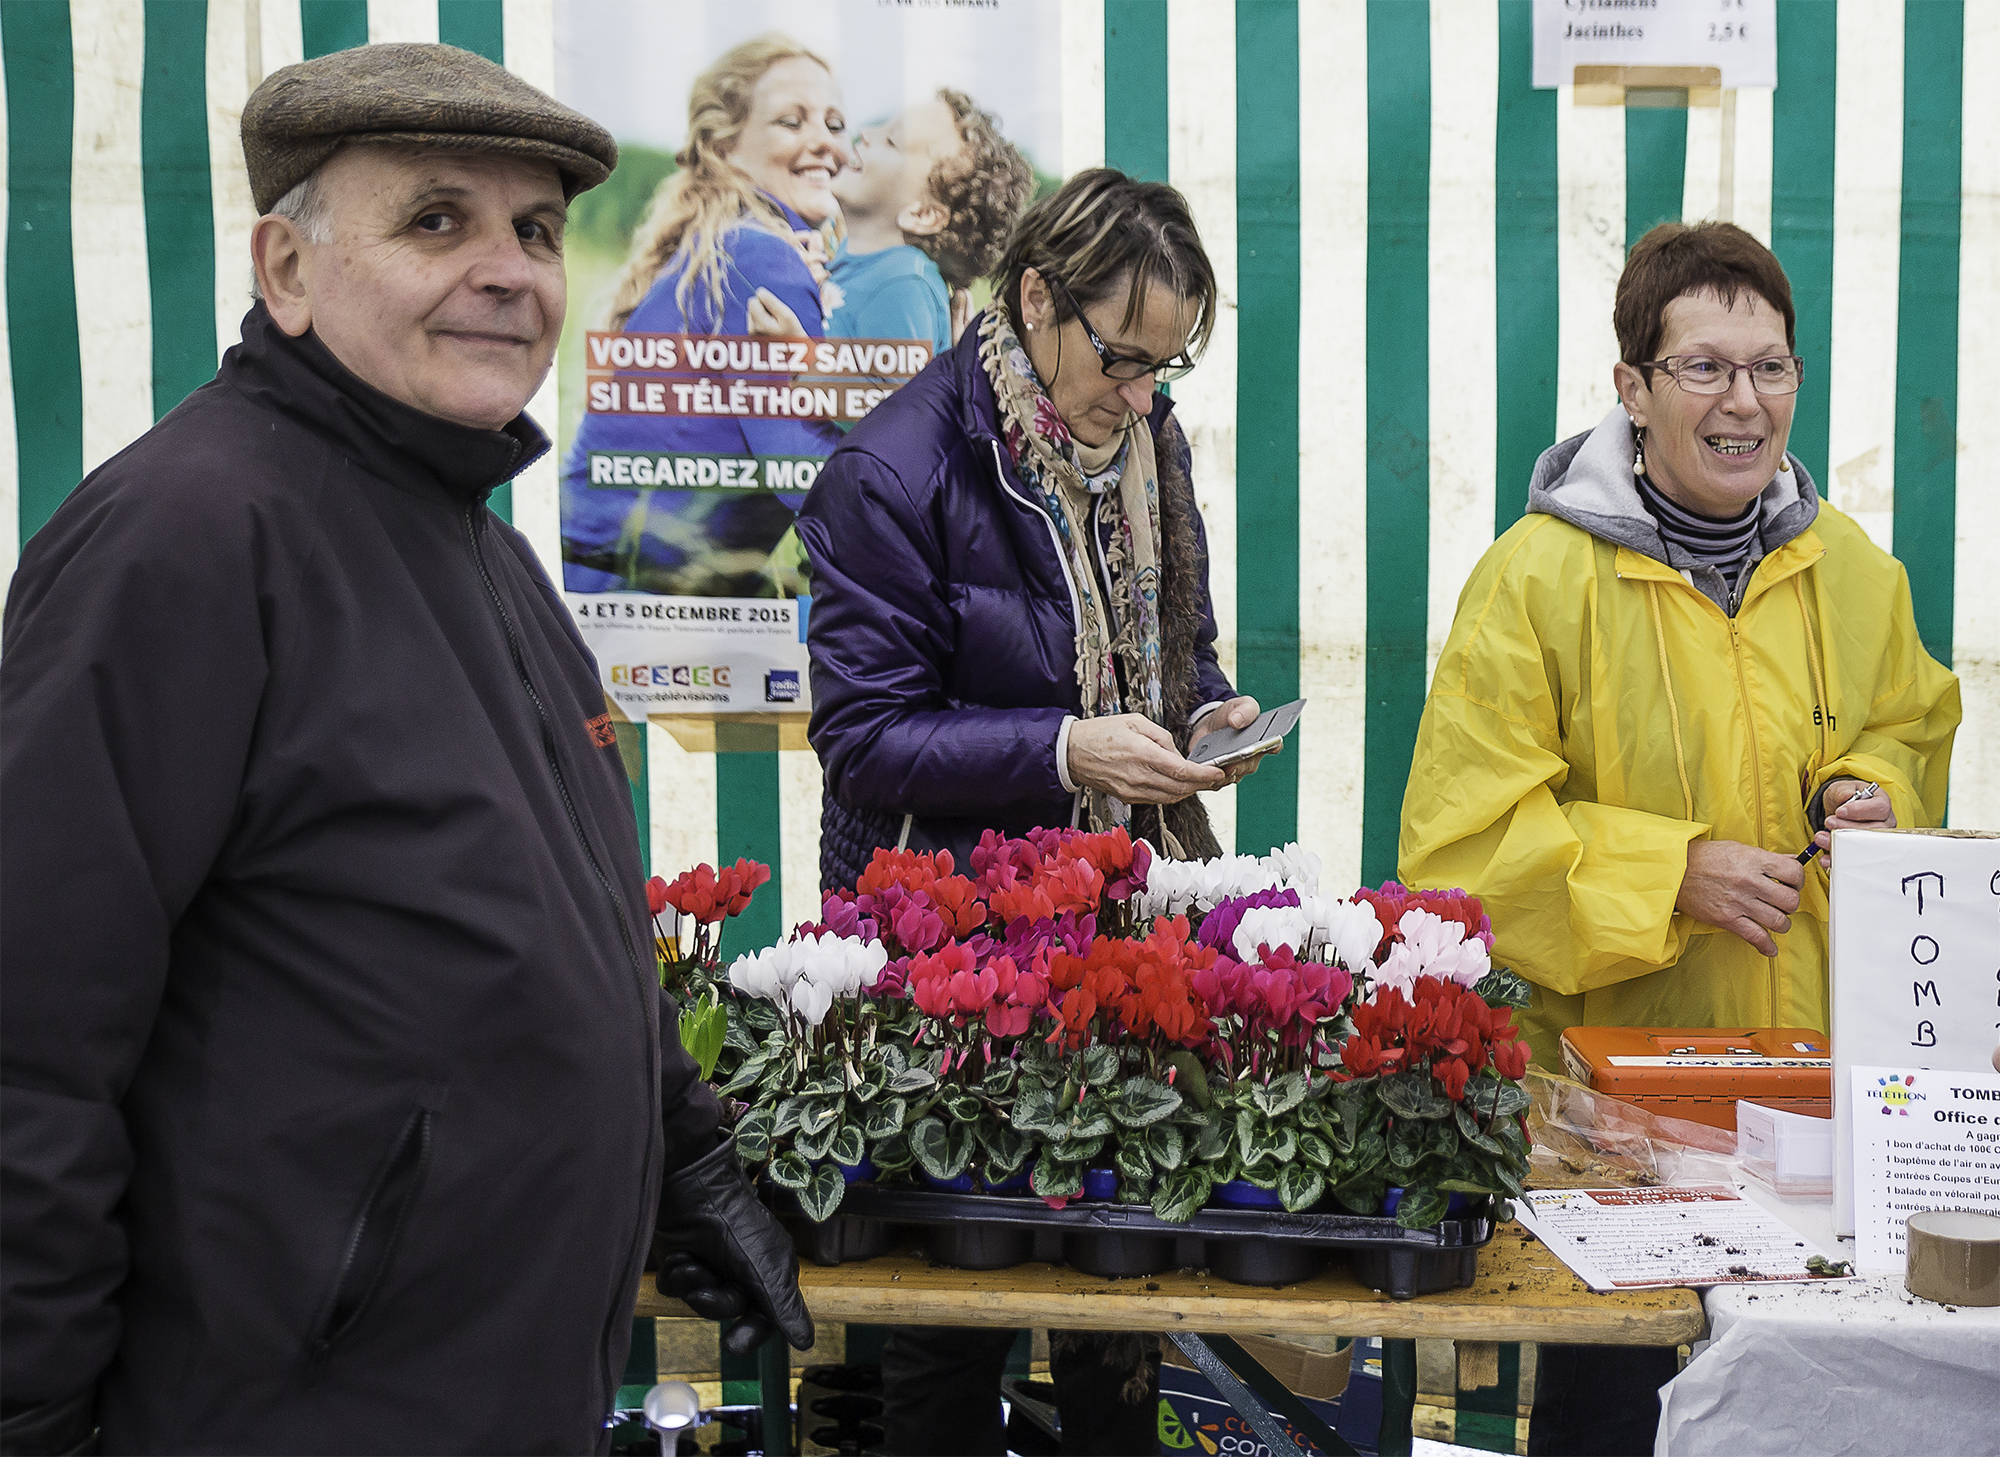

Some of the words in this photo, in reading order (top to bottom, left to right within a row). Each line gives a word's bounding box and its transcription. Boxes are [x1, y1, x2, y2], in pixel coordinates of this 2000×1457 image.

[1564, 22, 1645, 41] Jacinthes
[1707, 22, 1734, 44] 2,5
[590, 337, 678, 369] VOUS
[684, 339, 809, 372] VOULEZ
[815, 343, 929, 374] SAVOIR
[589, 381, 621, 411] SI
[627, 382, 666, 412] LE
[671, 378, 837, 417] TÉLÉTHON
[845, 388, 894, 417] ES
[591, 455, 759, 488] REGARDEZ
[765, 460, 825, 490] MO
[579, 603, 590, 617] 4
[596, 603, 619, 618] ET
[625, 603, 635, 618] 5
[641, 601, 742, 621] DÉCEMBRE
[748, 607, 790, 623] 2015
[1866, 1088, 1927, 1101] TÉLÉTHON
[1950, 1087, 2000, 1101] TOMB
[1933, 1110, 1988, 1125] Office
[1966, 1130, 1974, 1139] A
[1885, 1139, 1890, 1148] 1
[1893, 1140, 1912, 1149] bon
[1915, 1141, 1951, 1152] d'achat
[1954, 1143, 1966, 1152] de
[1969, 1145, 1992, 1154] 100€
[1886, 1155, 1890, 1163] 1
[1893, 1155, 1936, 1166] baptême
[1939, 1158, 1951, 1167] de
[1954, 1159, 1972, 1168] l'air
[1975, 1161, 1987, 1169] en
[1885, 1170, 1891, 1179] 2
[1893, 1171, 1931, 1181] entrées
[1933, 1173, 1971, 1184] Coupes
[1886, 1186, 1891, 1194] 1
[1894, 1186, 1927, 1196] balade
[1929, 1189, 1942, 1197] en
[1944, 1189, 1981, 1199] vélorail
[1886, 1201, 1892, 1210] 4
[1894, 1202, 1931, 1212] entrées
[1934, 1203, 1940, 1212] à
[1943, 1204, 1952, 1212] la
[1886, 1217, 1892, 1225] 7
[1887, 1232, 1892, 1240] 1
[1888, 1247, 1892, 1255] 1
